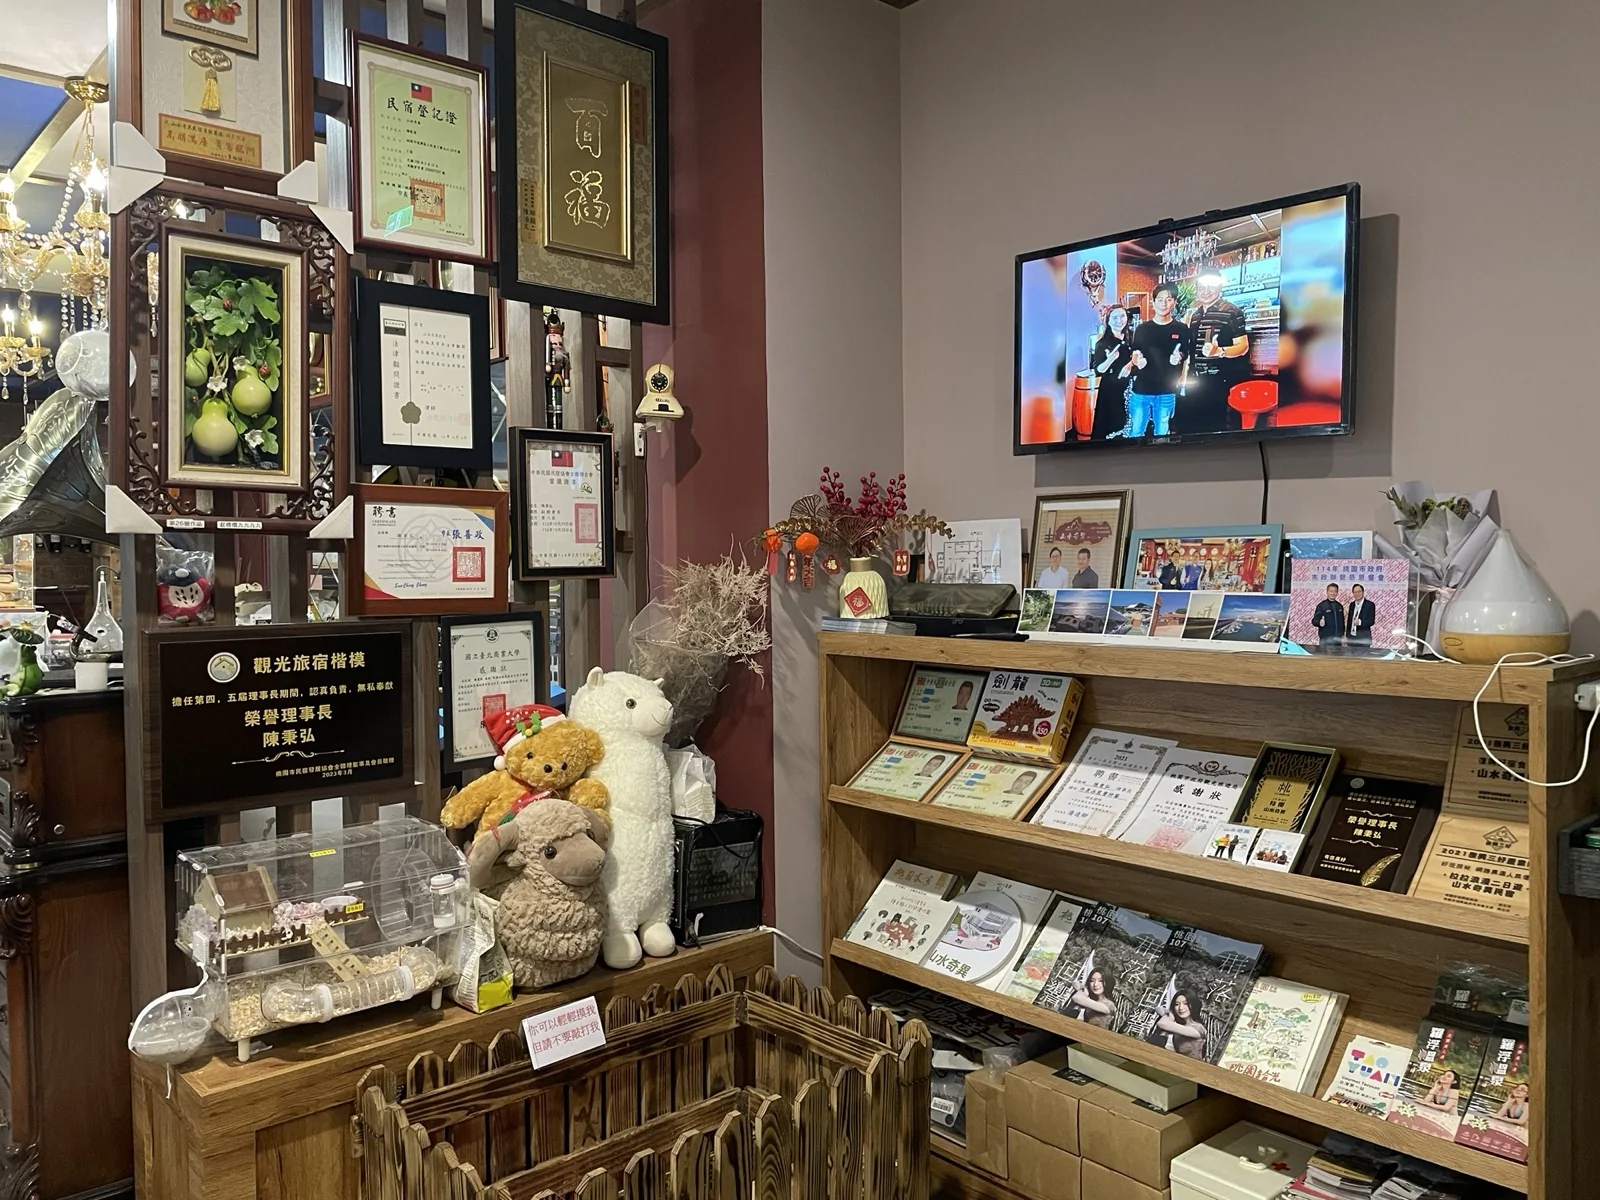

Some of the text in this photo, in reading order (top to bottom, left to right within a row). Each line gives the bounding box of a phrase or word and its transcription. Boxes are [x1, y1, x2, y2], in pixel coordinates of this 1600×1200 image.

[387, 97, 458, 125] 民宿登記證
[392, 340, 401, 400] 法律顧問證書
[372, 505, 397, 519] 聘書
[452, 529, 485, 540] 張善政
[827, 559, 838, 570] 福
[1342, 565, 1383, 573] 桃園市政府
[465, 649, 520, 661] 國立臺北商業大學
[253, 651, 366, 675] 觀光旅宿楷模
[479, 665, 508, 675] 感謝狀
[992, 673, 1030, 691] 劍龍
[244, 703, 333, 727] 榮譽理事長
[262, 727, 316, 748] 陳秉弘
[1036, 727, 1048, 737] 350
[1114, 754, 1128, 762] 2021
[321, 769, 353, 778] 2023年3月
[1173, 784, 1222, 801] 感謝狀
[1347, 815, 1398, 830] 榮譽理事長
[1353, 828, 1382, 839] 陳秉弘
[1091, 914, 1110, 925] 107
[1169, 939, 1187, 949] 107
[528, 1004, 597, 1037] 你可以輕輕摸我
[532, 1020, 600, 1054] 但請不要敲打我
